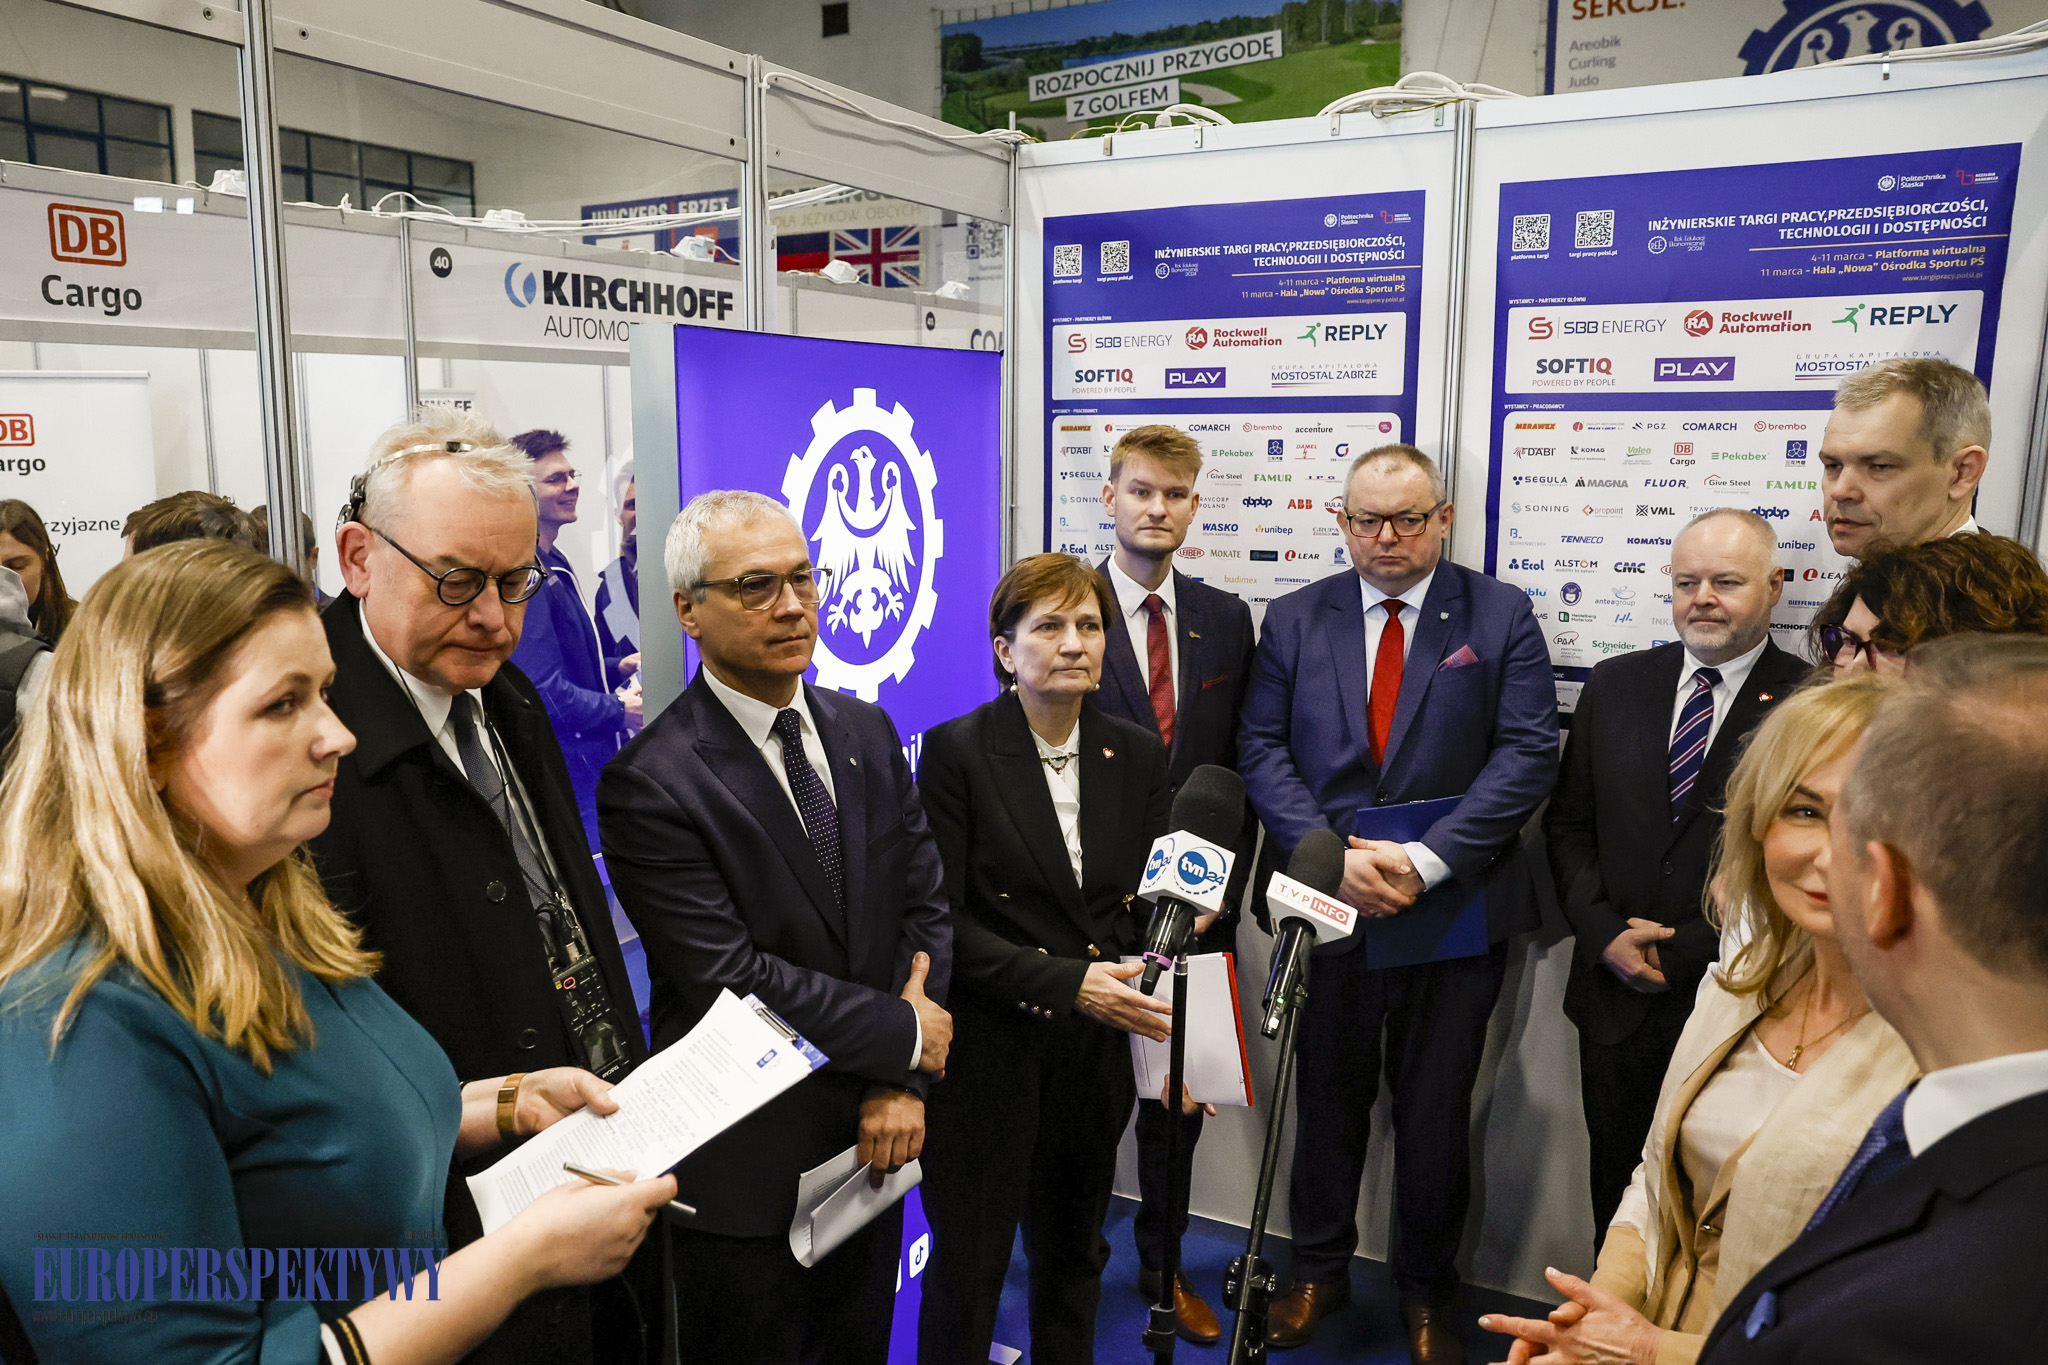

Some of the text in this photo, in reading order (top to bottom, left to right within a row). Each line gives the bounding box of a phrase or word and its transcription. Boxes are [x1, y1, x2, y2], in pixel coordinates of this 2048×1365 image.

[1569, 35, 1621, 52] Areobik
[1036, 37, 1273, 95] ROZPOCZNIJ PRZYGODĘ
[1569, 56, 1616, 70] Curling
[1568, 75, 1600, 88] Judo
[1073, 86, 1168, 117] Z GOLFEM
[1900, 174, 1947, 182] Politechnika
[866, 205, 921, 219] OBCYCH
[1648, 217, 1736, 231] INŻYNIERSKIE
[1739, 213, 1778, 226] TARGI
[1778, 224, 1870, 240] TECHNOLOGII
[1883, 214, 1987, 234] DOSTĘPNOŚCI
[59, 213, 117, 256] DB
[1155, 247, 1220, 260] INŻYNIERSKIE
[1223, 244, 1252, 255] TARGI
[1253, 254, 1322, 267] TECHNOLOGII
[1330, 248, 1405, 264] DOSTĘPNOŚCI
[1811, 245, 1986, 262] 4-11 marca Platforma wirtualna
[434, 256, 449, 269] 40
[1772, 268, 1802, 276] marca
[1813, 266, 1836, 275] Hala
[1881, 260, 1926, 271] Ośrodka
[1929, 259, 1967, 270] Sportu
[1970, 256, 1985, 266] PŚ
[1295, 278, 1319, 286] marca
[1326, 276, 1365, 285] Platforma
[1367, 274, 1406, 283] wirtualna
[41, 274, 142, 317] Cargo
[543, 270, 734, 321] KIRCHHOFF
[1330, 286, 1364, 295] Ośrodka
[1365, 285, 1393, 296] Sportu
[1394, 283, 1406, 292] PŚ
[1722, 310, 1793, 322] Rockwell
[1870, 304, 1959, 326] REPLY
[544, 315, 630, 342] AUTOMO
[1325, 324, 1388, 341] REPLY
[1564, 319, 1667, 334] SBB ENERGY
[1719, 321, 1812, 334] Automation
[1214, 328, 1268, 338] Rockwell
[1095, 334, 1173, 348] SBB ENERGY
[1213, 337, 1282, 347] Automation
[1849, 350, 1941, 359] KAPITAŁOWA
[1536, 358, 1613, 375] SOFTIQ
[1660, 361, 1729, 377] PLAY
[1795, 360, 1876, 372] MOSTOSTA
[1074, 369, 1134, 383] SOFTIQ
[1169, 371, 1222, 385] PLAY
[1271, 369, 1378, 381] MOSTOSTAL ZABRZE
[1532, 379, 1571, 387] POWERED
[1586, 378, 1616, 386] PEOPLE
[1682, 422, 1738, 431] COMARCH
[1768, 422, 1807, 430] brembo
[1220, 449, 1254, 457] Pekabex
[1627, 446, 1652, 454] Valeo
[1676, 444, 1691, 453] DB
[1669, 458, 1696, 466] Cargo
[1721, 452, 1767, 460] Pekabex
[0, 458, 46, 476] rgo
[1254, 474, 1293, 482] FAMUR
[1587, 480, 1629, 488] MAGNA
[1644, 479, 1688, 488] FLUOR
[1766, 480, 1818, 490] FAMUR
[1287, 499, 1313, 509] ABB
[1525, 505, 1570, 513] SONING
[1595, 507, 1624, 515] propoint
[1650, 507, 1676, 516] VML
[43, 517, 120, 536] zyjazne
[1202, 523, 1239, 532] WASKO
[1264, 526, 1293, 536] unibep
[1560, 535, 1604, 544] TENNECO
[1627, 537, 1672, 545] KOMATSU
[1777, 540, 1816, 551] unibep
[1070, 543, 1088, 554] Ecol
[1210, 549, 1241, 558] MOKATE
[1521, 559, 1545, 571] Ecol
[1554, 560, 1598, 569] ALSTOM
[1613, 562, 1646, 573] CMC
[1224, 575, 1258, 584] budimex
[1594, 599, 1636, 607] anteagroup
[1592, 640, 1637, 651] Schneider
[1149, 858, 1162, 871] tvn
[1181, 856, 1225, 885] tvn 24
[1280, 883, 1347, 922] TVP INFO
